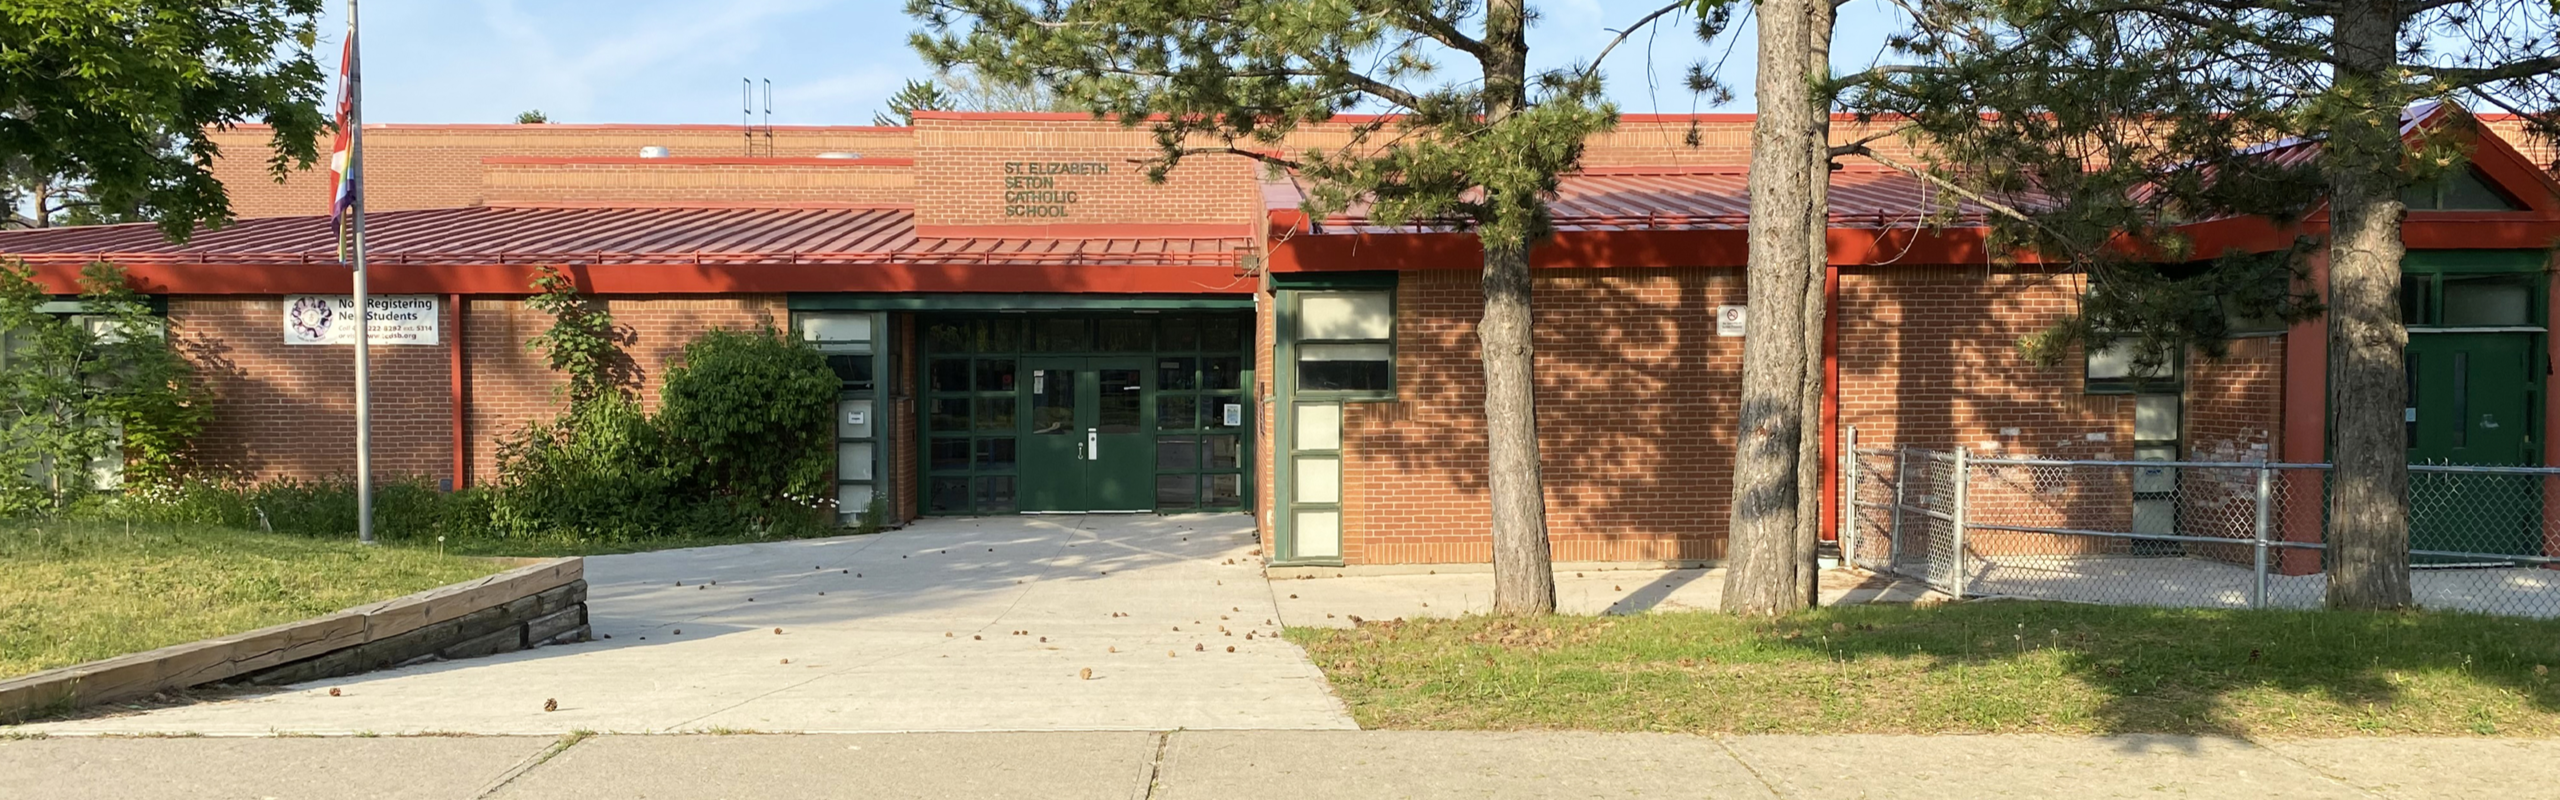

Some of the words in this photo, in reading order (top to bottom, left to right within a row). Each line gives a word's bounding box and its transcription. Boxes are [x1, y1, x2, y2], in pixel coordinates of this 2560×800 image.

[1004, 161, 1023, 175] ST.
[1029, 162, 1108, 175] ELIZABETH
[1004, 176, 1053, 189] SETON
[1005, 190, 1077, 204] CATHOLIC
[1005, 205, 1068, 217] SCHOOL
[338, 298, 359, 309] No
[367, 298, 432, 310] Registering
[338, 311, 359, 321] Ne
[366, 311, 418, 321] Students
